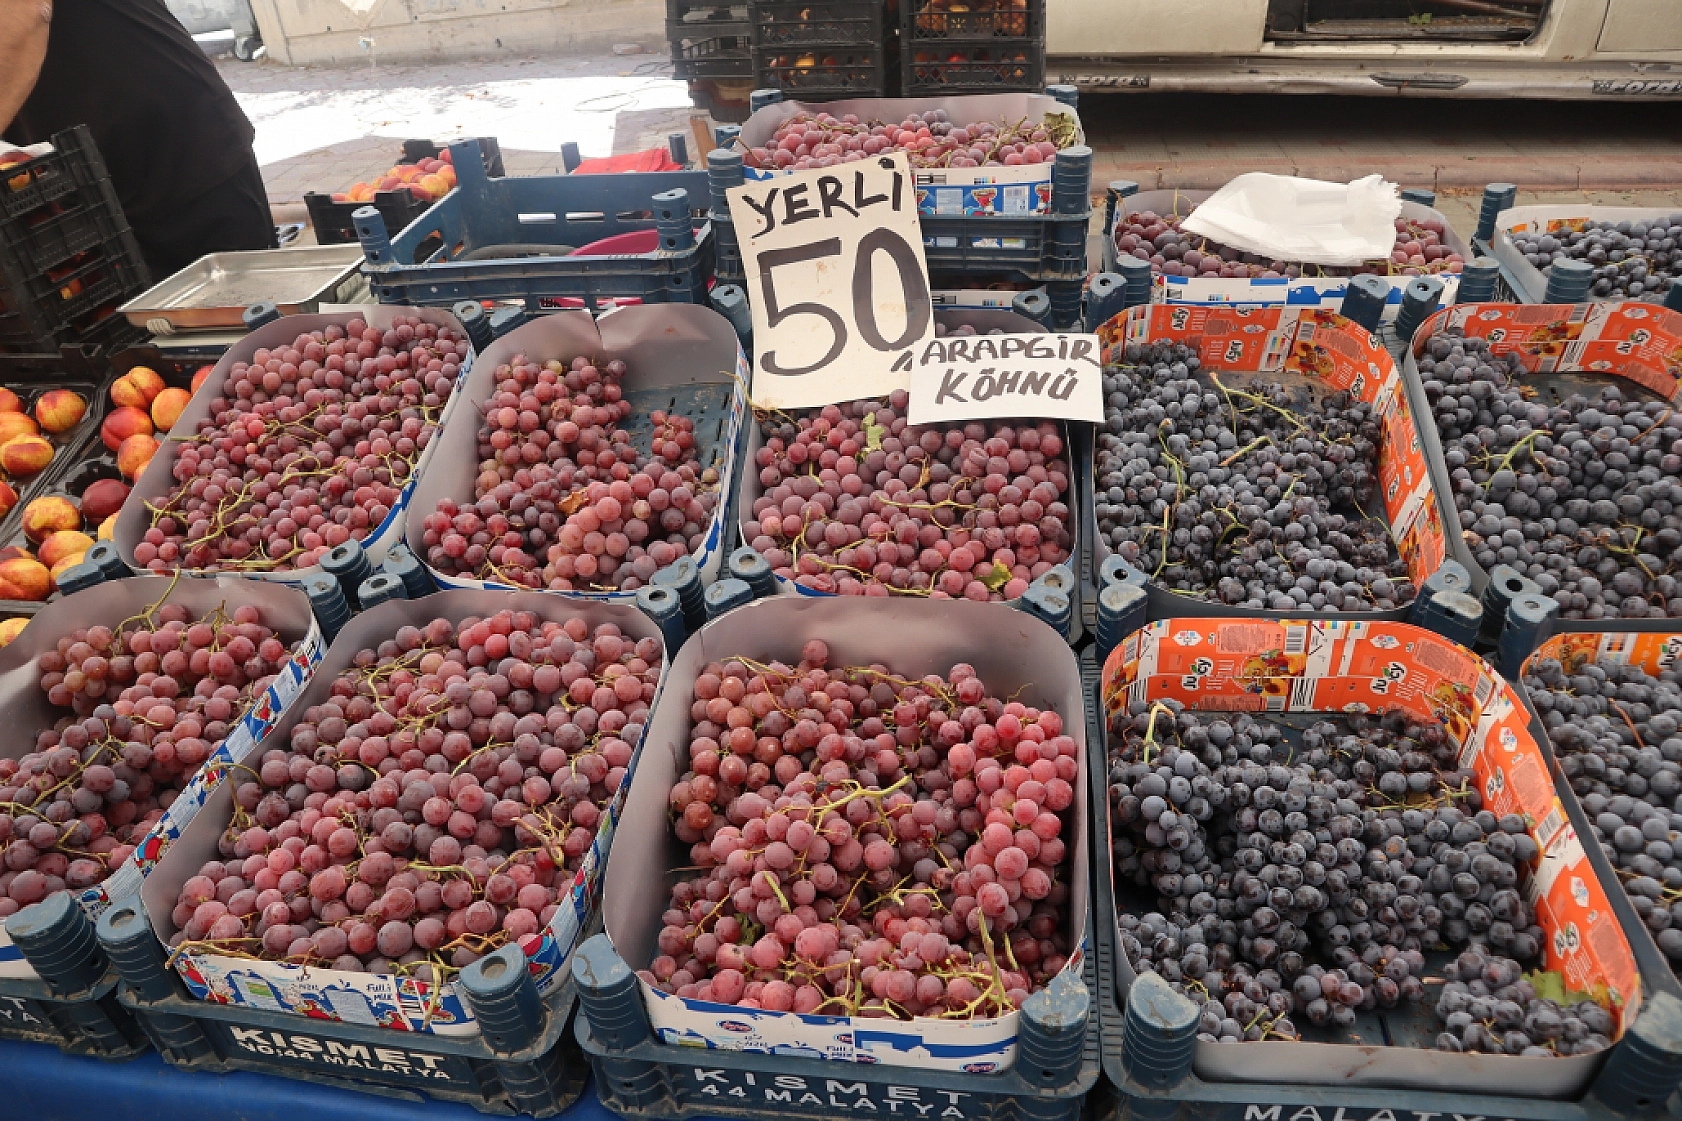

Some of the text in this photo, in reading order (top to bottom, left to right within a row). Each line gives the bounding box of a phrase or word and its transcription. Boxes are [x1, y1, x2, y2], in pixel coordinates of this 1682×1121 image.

[742, 157, 903, 239] YERLİ
[756, 227, 931, 376] 50
[920, 335, 1100, 368] ARAPGİR
[935, 367, 1079, 405] KÖHNÜ
[229, 1025, 446, 1068] KISMET
[321, 1053, 451, 1080] MALATYA
[694, 1068, 972, 1105] KISMET
[701, 1083, 966, 1119] 44 MALATYA
